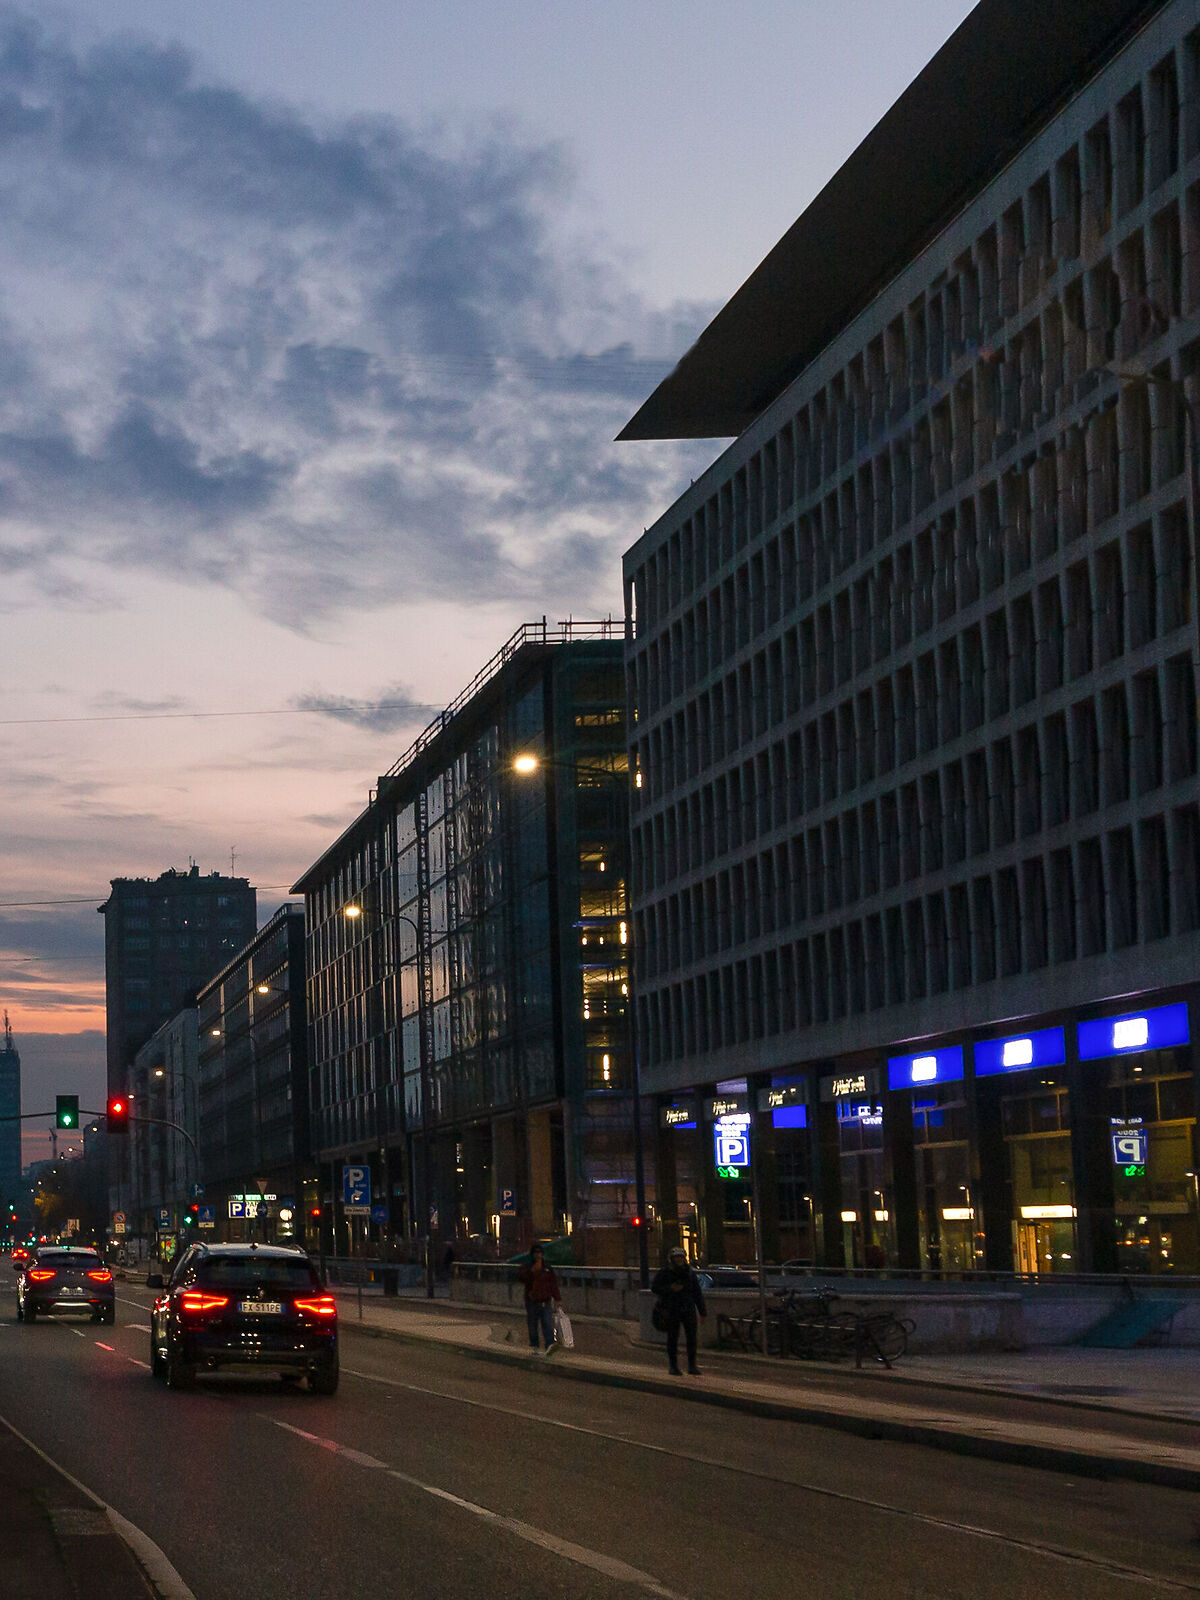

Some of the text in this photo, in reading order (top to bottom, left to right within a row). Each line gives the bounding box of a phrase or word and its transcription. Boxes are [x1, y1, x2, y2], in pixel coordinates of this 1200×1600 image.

[722, 1139, 742, 1163] P
[349, 1169, 364, 1188] P
[503, 1190, 512, 1201] P
[160, 1210, 168, 1219] P
[232, 1203, 243, 1216] P
